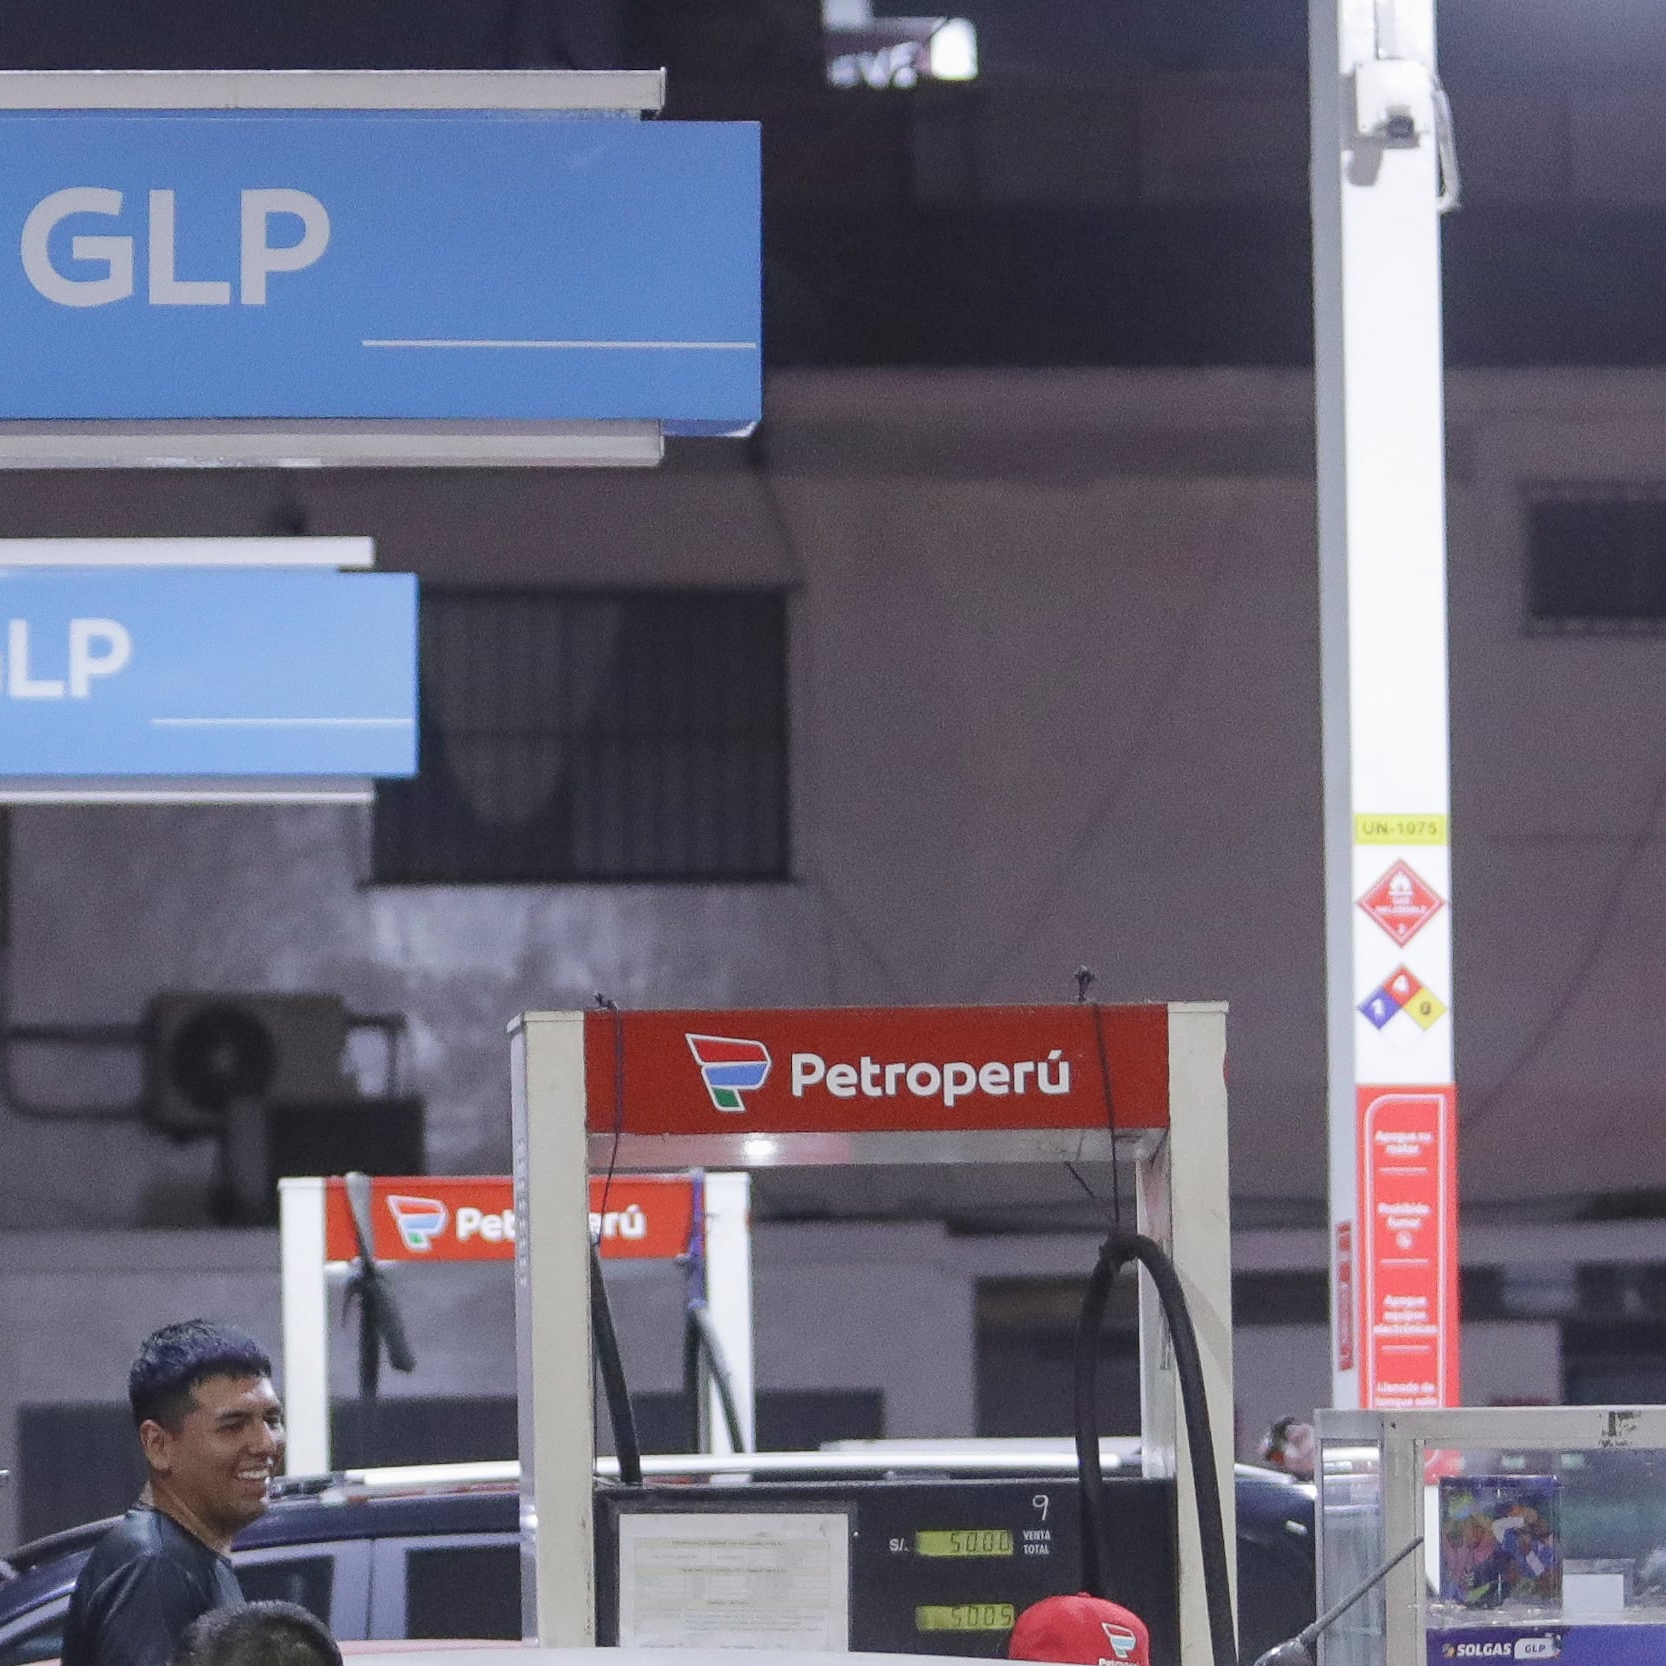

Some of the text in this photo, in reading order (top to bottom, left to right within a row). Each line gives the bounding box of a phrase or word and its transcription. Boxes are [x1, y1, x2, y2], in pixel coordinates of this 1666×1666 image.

[21, 186, 330, 307] GLP
[1362, 821, 1437, 834] UN-1075
[792, 1048, 1070, 1106] Petroperú
[456, 1204, 647, 1242] Peterú
[1033, 1494, 1049, 1521] 9
[1023, 1530, 1051, 1541] VENTA
[1023, 1544, 1050, 1555] TOTAL
[1456, 1643, 1546, 1657] SOLGAS GLP
